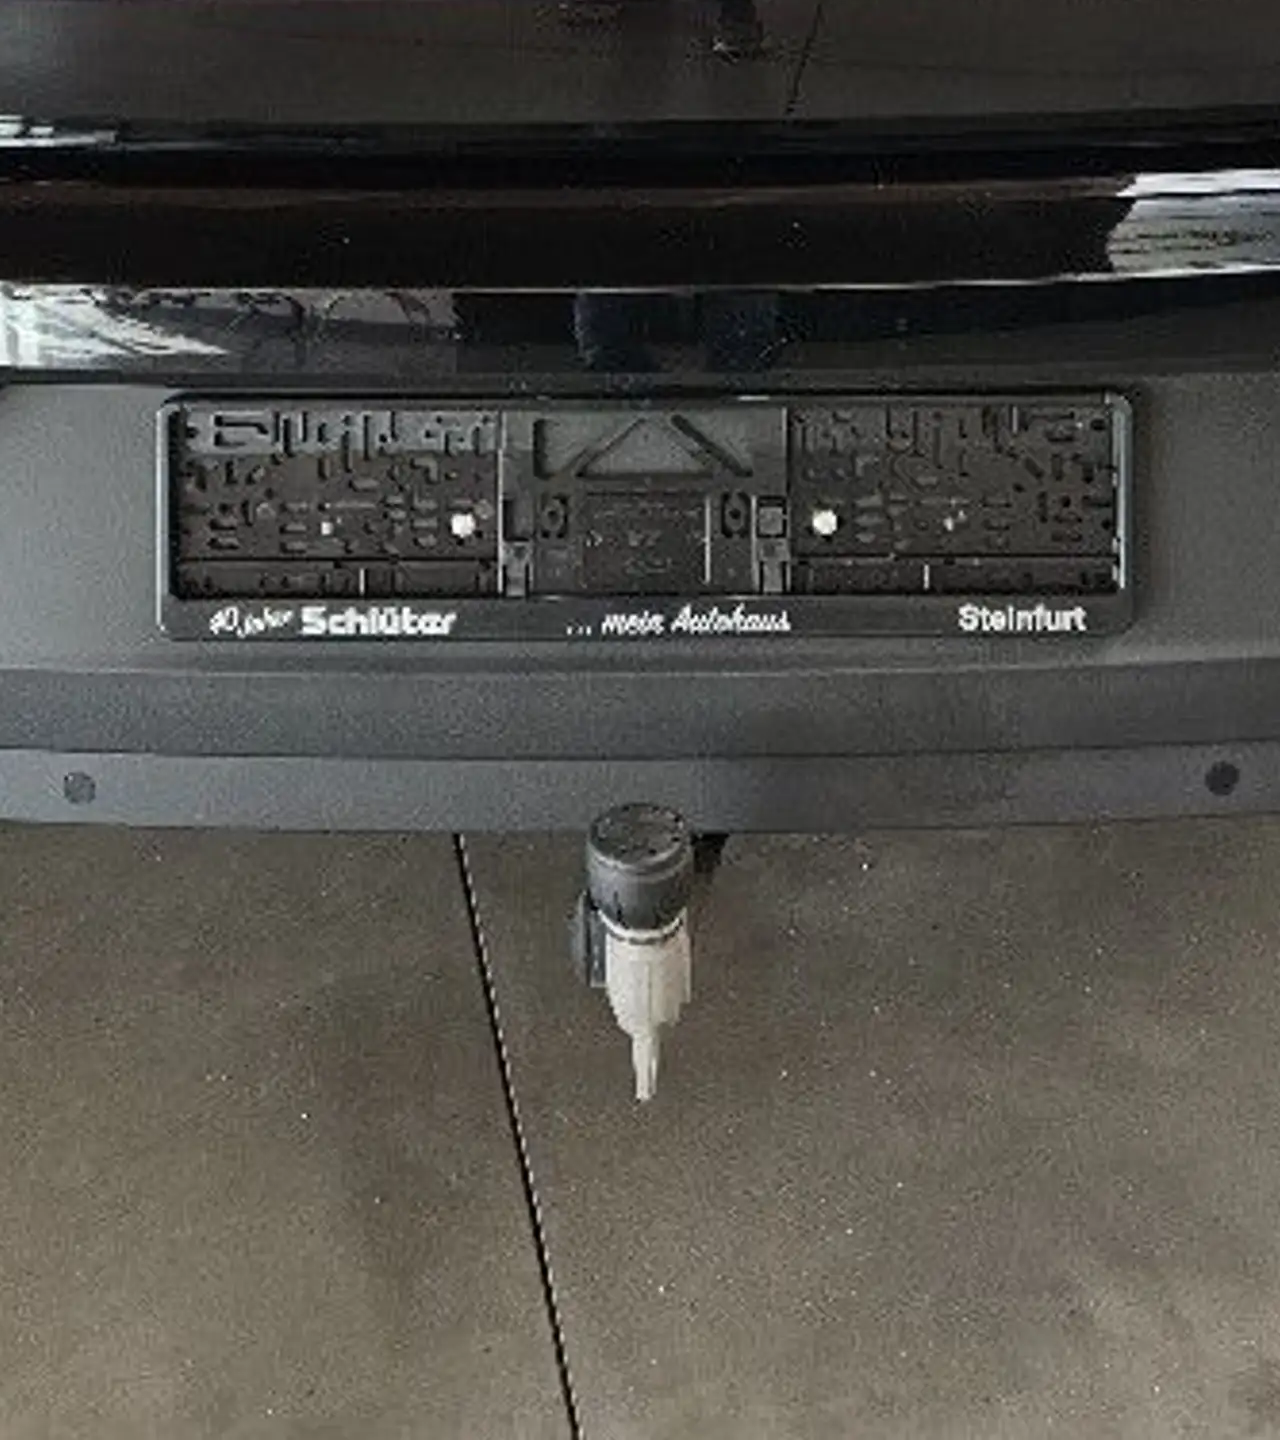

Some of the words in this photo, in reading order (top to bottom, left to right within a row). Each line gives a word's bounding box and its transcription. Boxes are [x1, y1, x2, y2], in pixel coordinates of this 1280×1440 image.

[299, 605, 458, 636] Schlüter
[601, 610, 665, 636] mein
[670, 603, 792, 635] Autohaus
[958, 602, 1088, 633] Steinfurt
